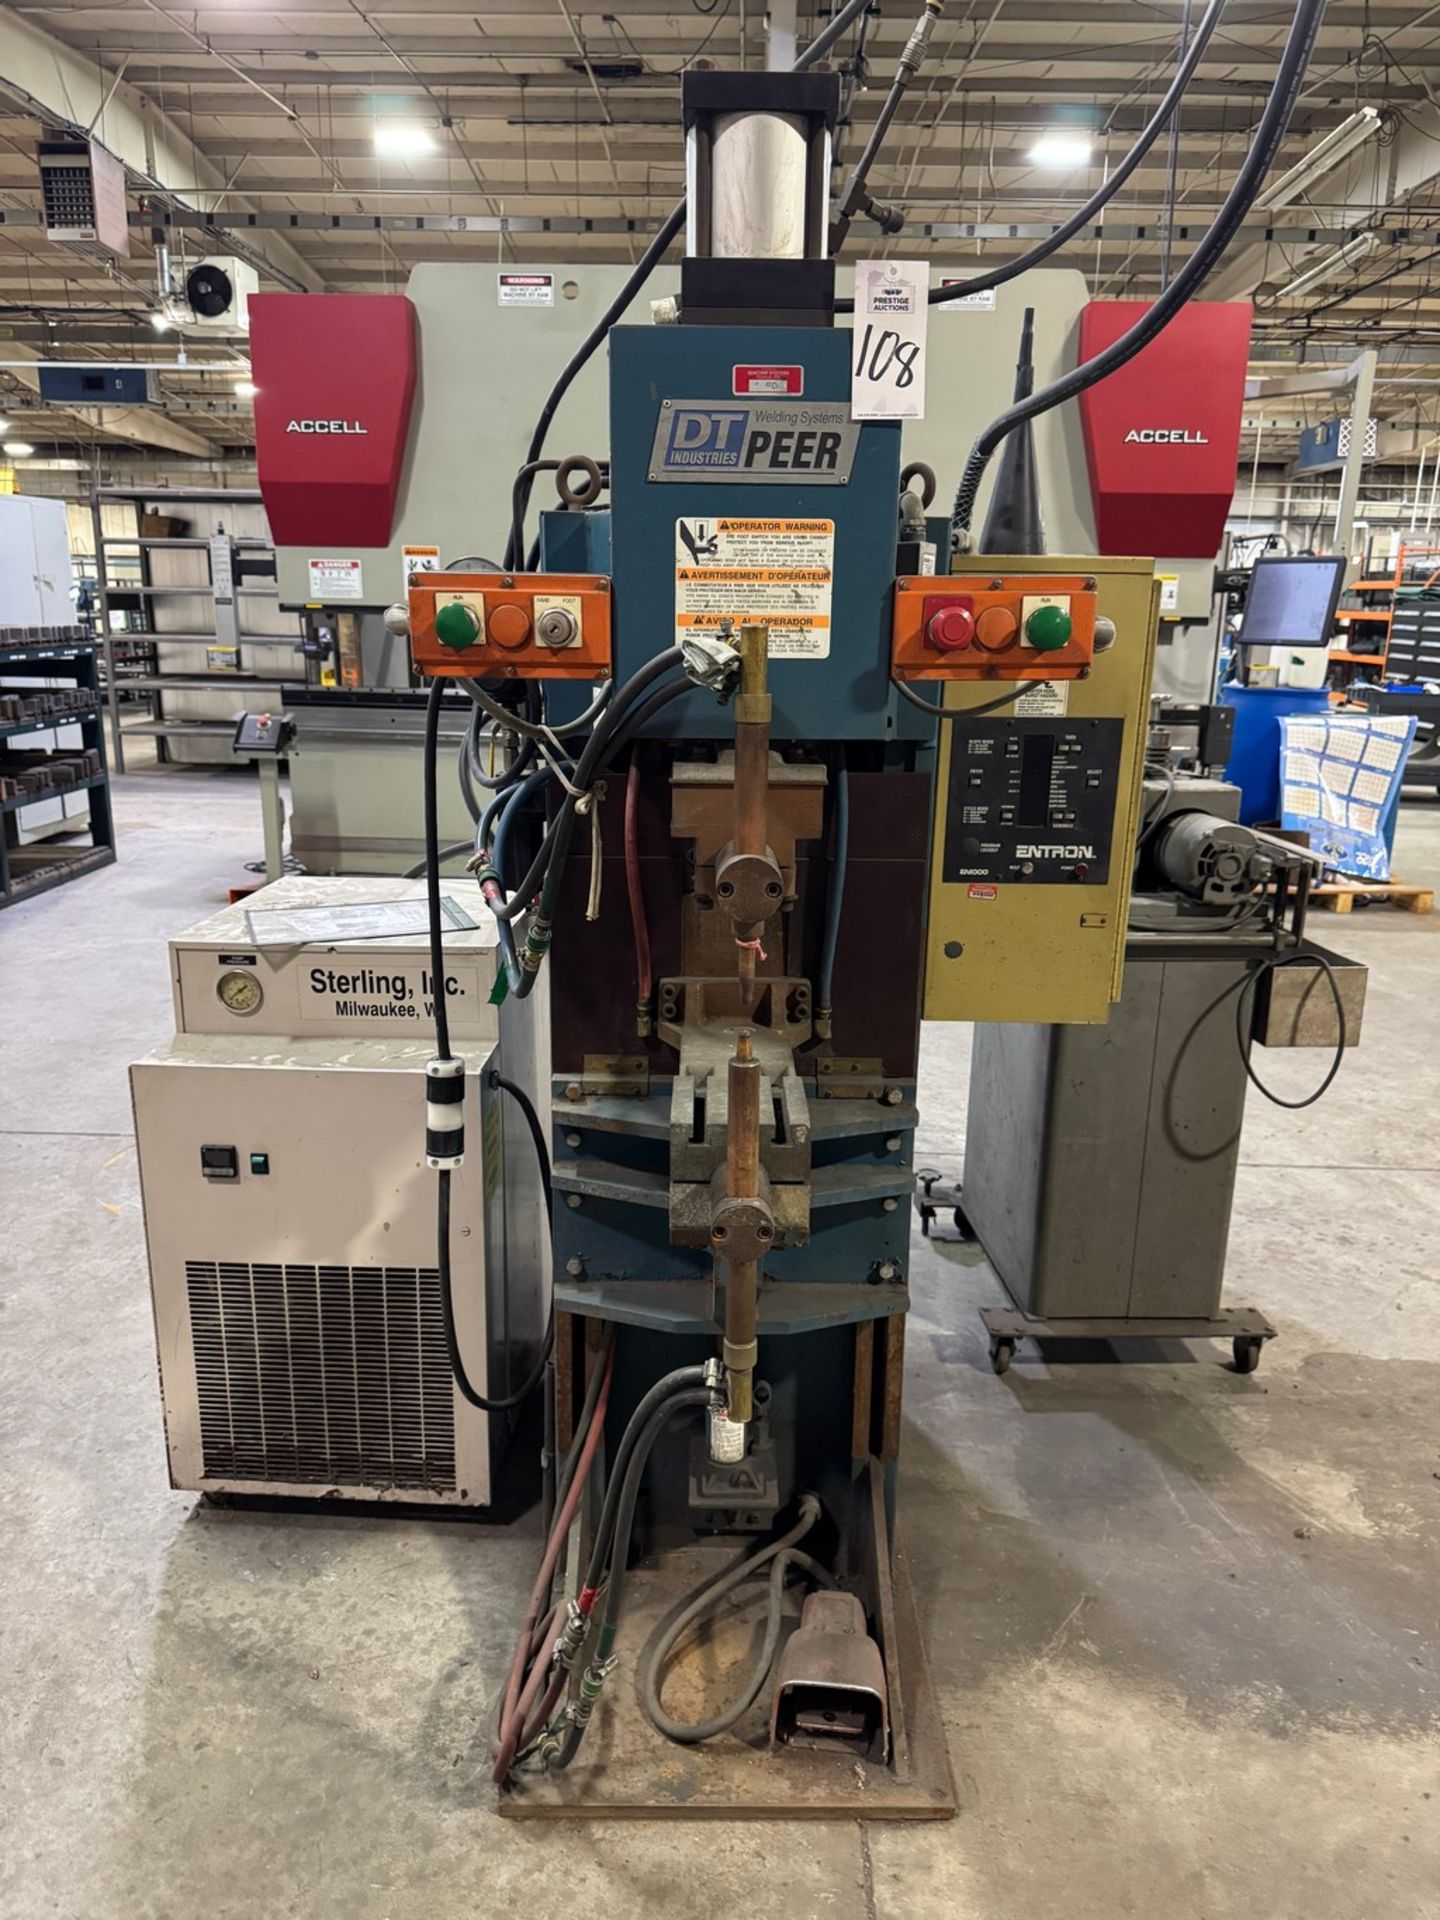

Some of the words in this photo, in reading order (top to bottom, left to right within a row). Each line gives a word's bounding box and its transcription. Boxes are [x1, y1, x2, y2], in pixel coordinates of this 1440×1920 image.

[855, 324, 920, 388] 108
[755, 410, 798, 426] Welding
[800, 411, 844, 426] Systems
[286, 420, 368, 433] ACCELL
[673, 413, 744, 449] DT
[1124, 429, 1208, 443] ACCELL
[744, 431, 842, 469] PEER
[670, 451, 738, 465] INDUSTRIES
[732, 522, 780, 531] OPERATOR
[786, 522, 828, 531] WARNING
[691, 571, 763, 580] AVERTISSEMENT
[760, 617, 814, 625] OPERADOR
[1016, 845, 1094, 859] ENTRON
[310, 968, 414, 1001] Sterling,
[421, 970, 465, 996] Ic.
[335, 1000, 420, 1020] Milwaukee,
